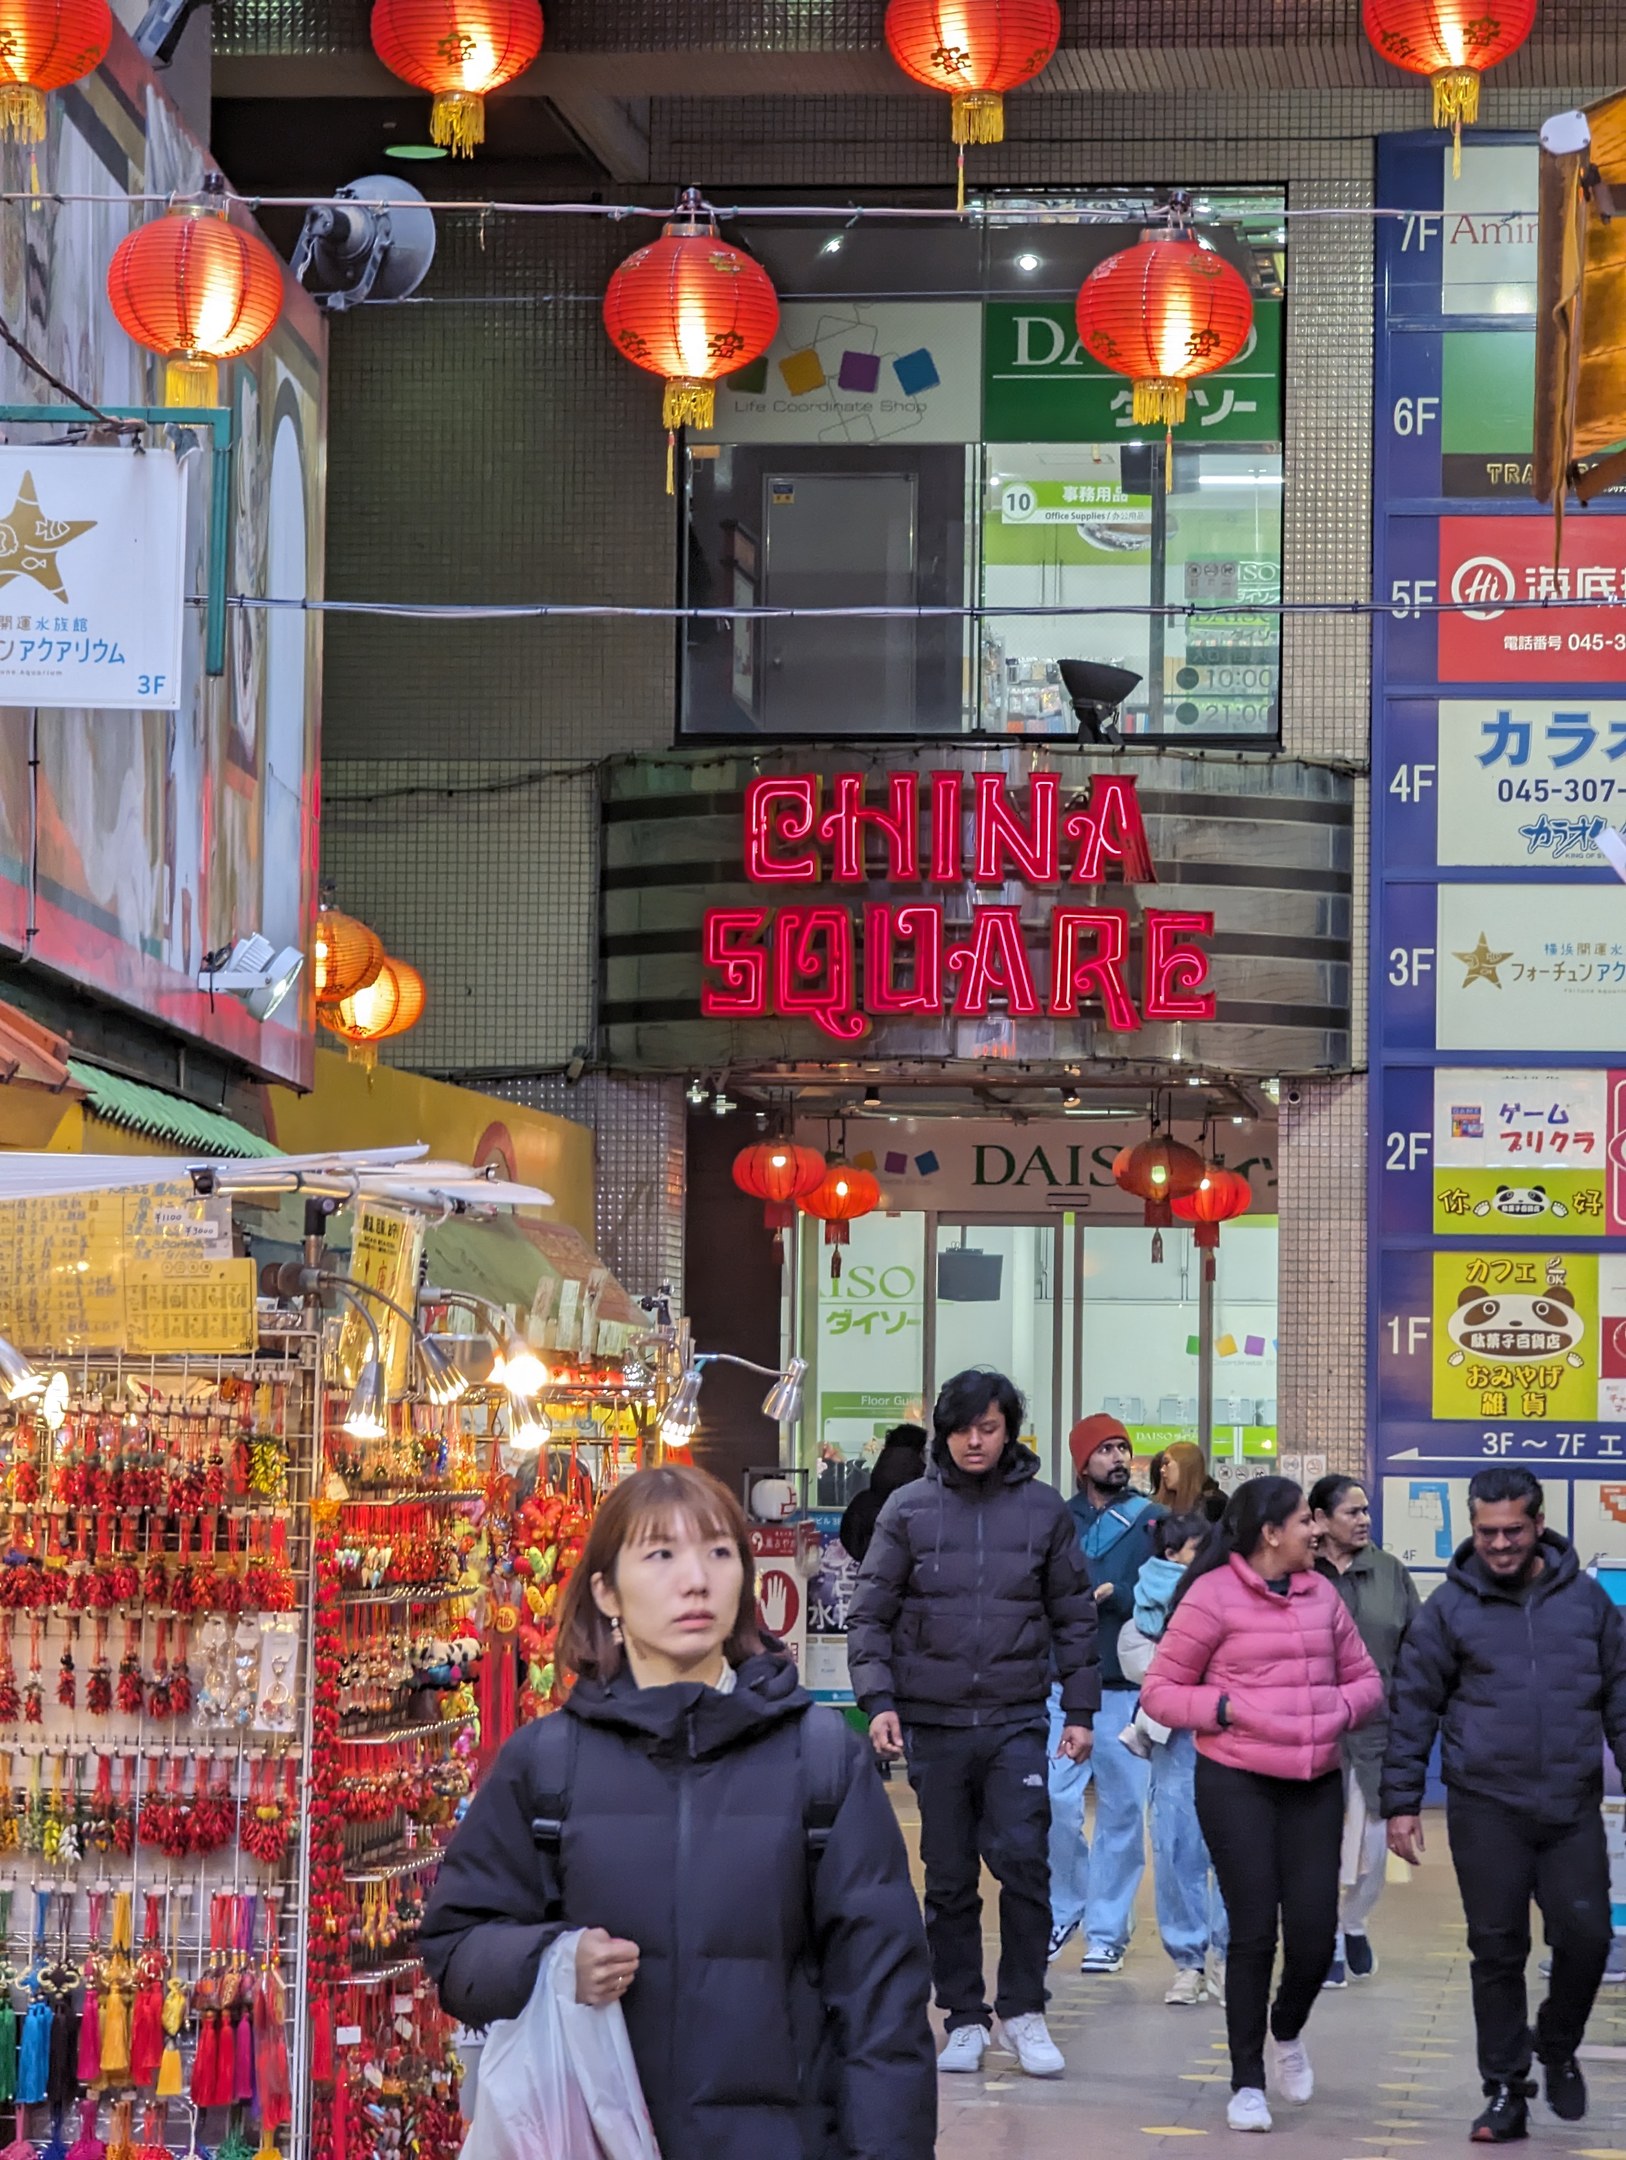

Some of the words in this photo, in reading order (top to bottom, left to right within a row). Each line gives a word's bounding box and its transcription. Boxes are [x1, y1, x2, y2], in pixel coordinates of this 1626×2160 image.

[1397, 214, 1442, 252] 7F
[735, 400, 766, 413] Life
[773, 400, 873, 413] Coordinate
[880, 400, 927, 414] Shop
[1393, 397, 1440, 436] 6F
[1006, 492, 1031, 511] 10
[1062, 485, 1129, 503] 事務用品
[1045, 511, 1070, 521] Office
[1071, 511, 1106, 522] Supplies
[1237, 565, 1277, 581] ISO
[1525, 566, 1626, 607] 海底
[1391, 580, 1437, 619] 5F
[0, 616, 88, 632] 開運水族館
[1504, 634, 1563, 651] 電話番号
[137, 674, 167, 695] 3F
[1206, 668, 1273, 689] 10:00
[1389, 764, 1436, 803] 4F
[745, 772, 1156, 885] CHINA
[701, 904, 1216, 1039] SQUARE
[1388, 947, 1435, 987] 3F
[1499, 1102, 1569, 1125] ゲーム
[1386, 1132, 1433, 1171] 2F
[1500, 1130, 1595, 1154] プリクラ
[972, 1144, 1124, 1187] DAIS
[1438, 1187, 1471, 1217] 你
[1572, 1188, 1604, 1217] 好
[820, 1265, 917, 1299] ISO
[1467, 1257, 1537, 1284] カフェ
[1546, 1273, 1567, 1286] OK
[826, 1308, 922, 1335] ダイソー
[1387, 1315, 1431, 1355] 1F
[1470, 1332, 1562, 1350] 駄菓子百貨店
[1467, 1364, 1564, 1390] おみやげ
[861, 1394, 890, 1406] Floor
[1136, 1431, 1173, 1441] DAISO
[1482, 1432, 1515, 1455] 3F
[1556, 1432, 1586, 1455] 7F
[1402, 1549, 1417, 1561] 4F
